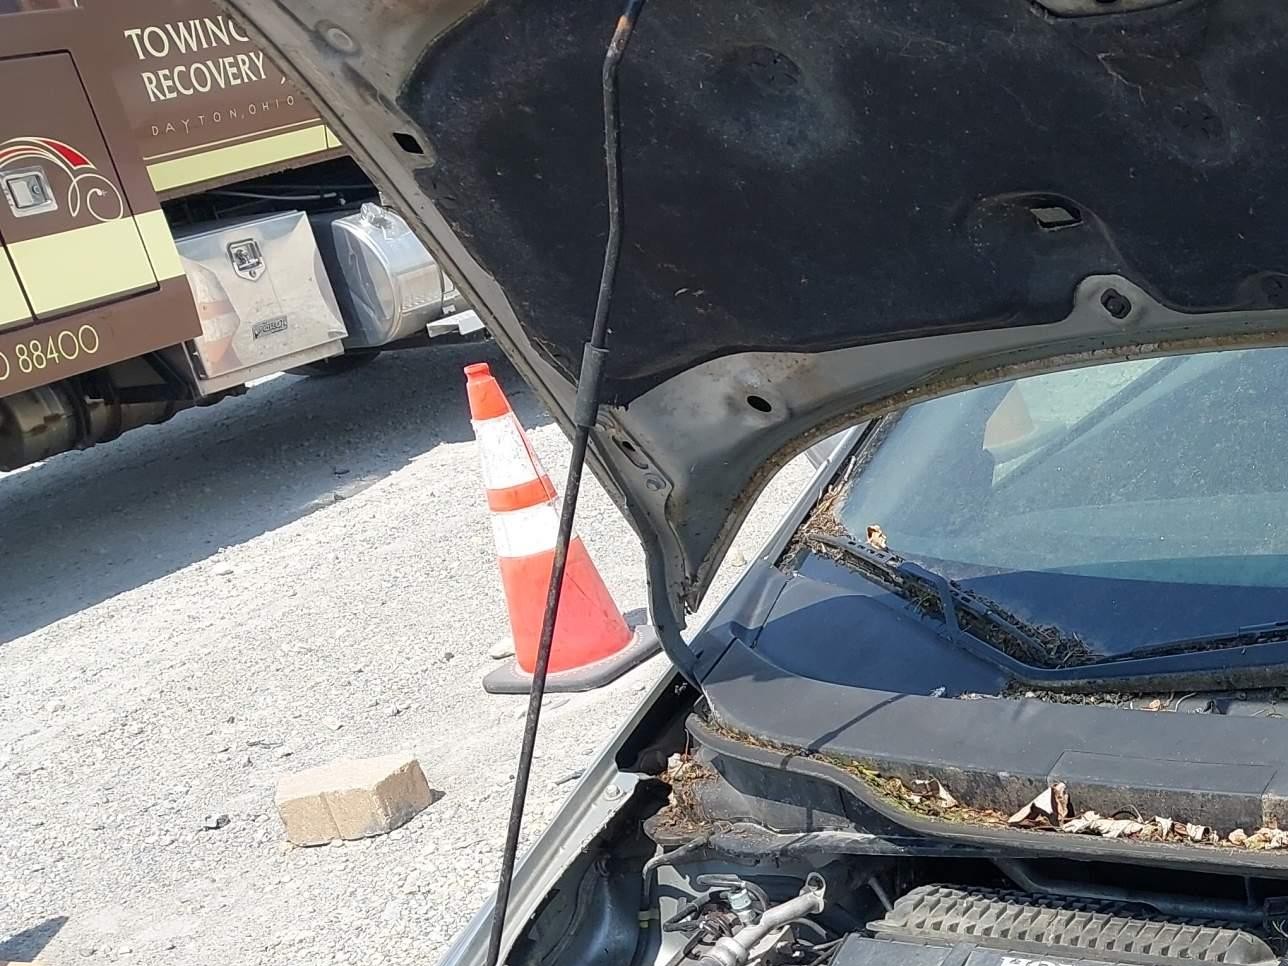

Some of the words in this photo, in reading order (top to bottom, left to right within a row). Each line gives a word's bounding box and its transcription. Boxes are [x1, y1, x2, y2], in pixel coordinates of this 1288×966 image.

[141, 51, 267, 102] RECOVERY
[248, 95, 294, 115] OHIO
[15, 325, 99, 373] 88400
